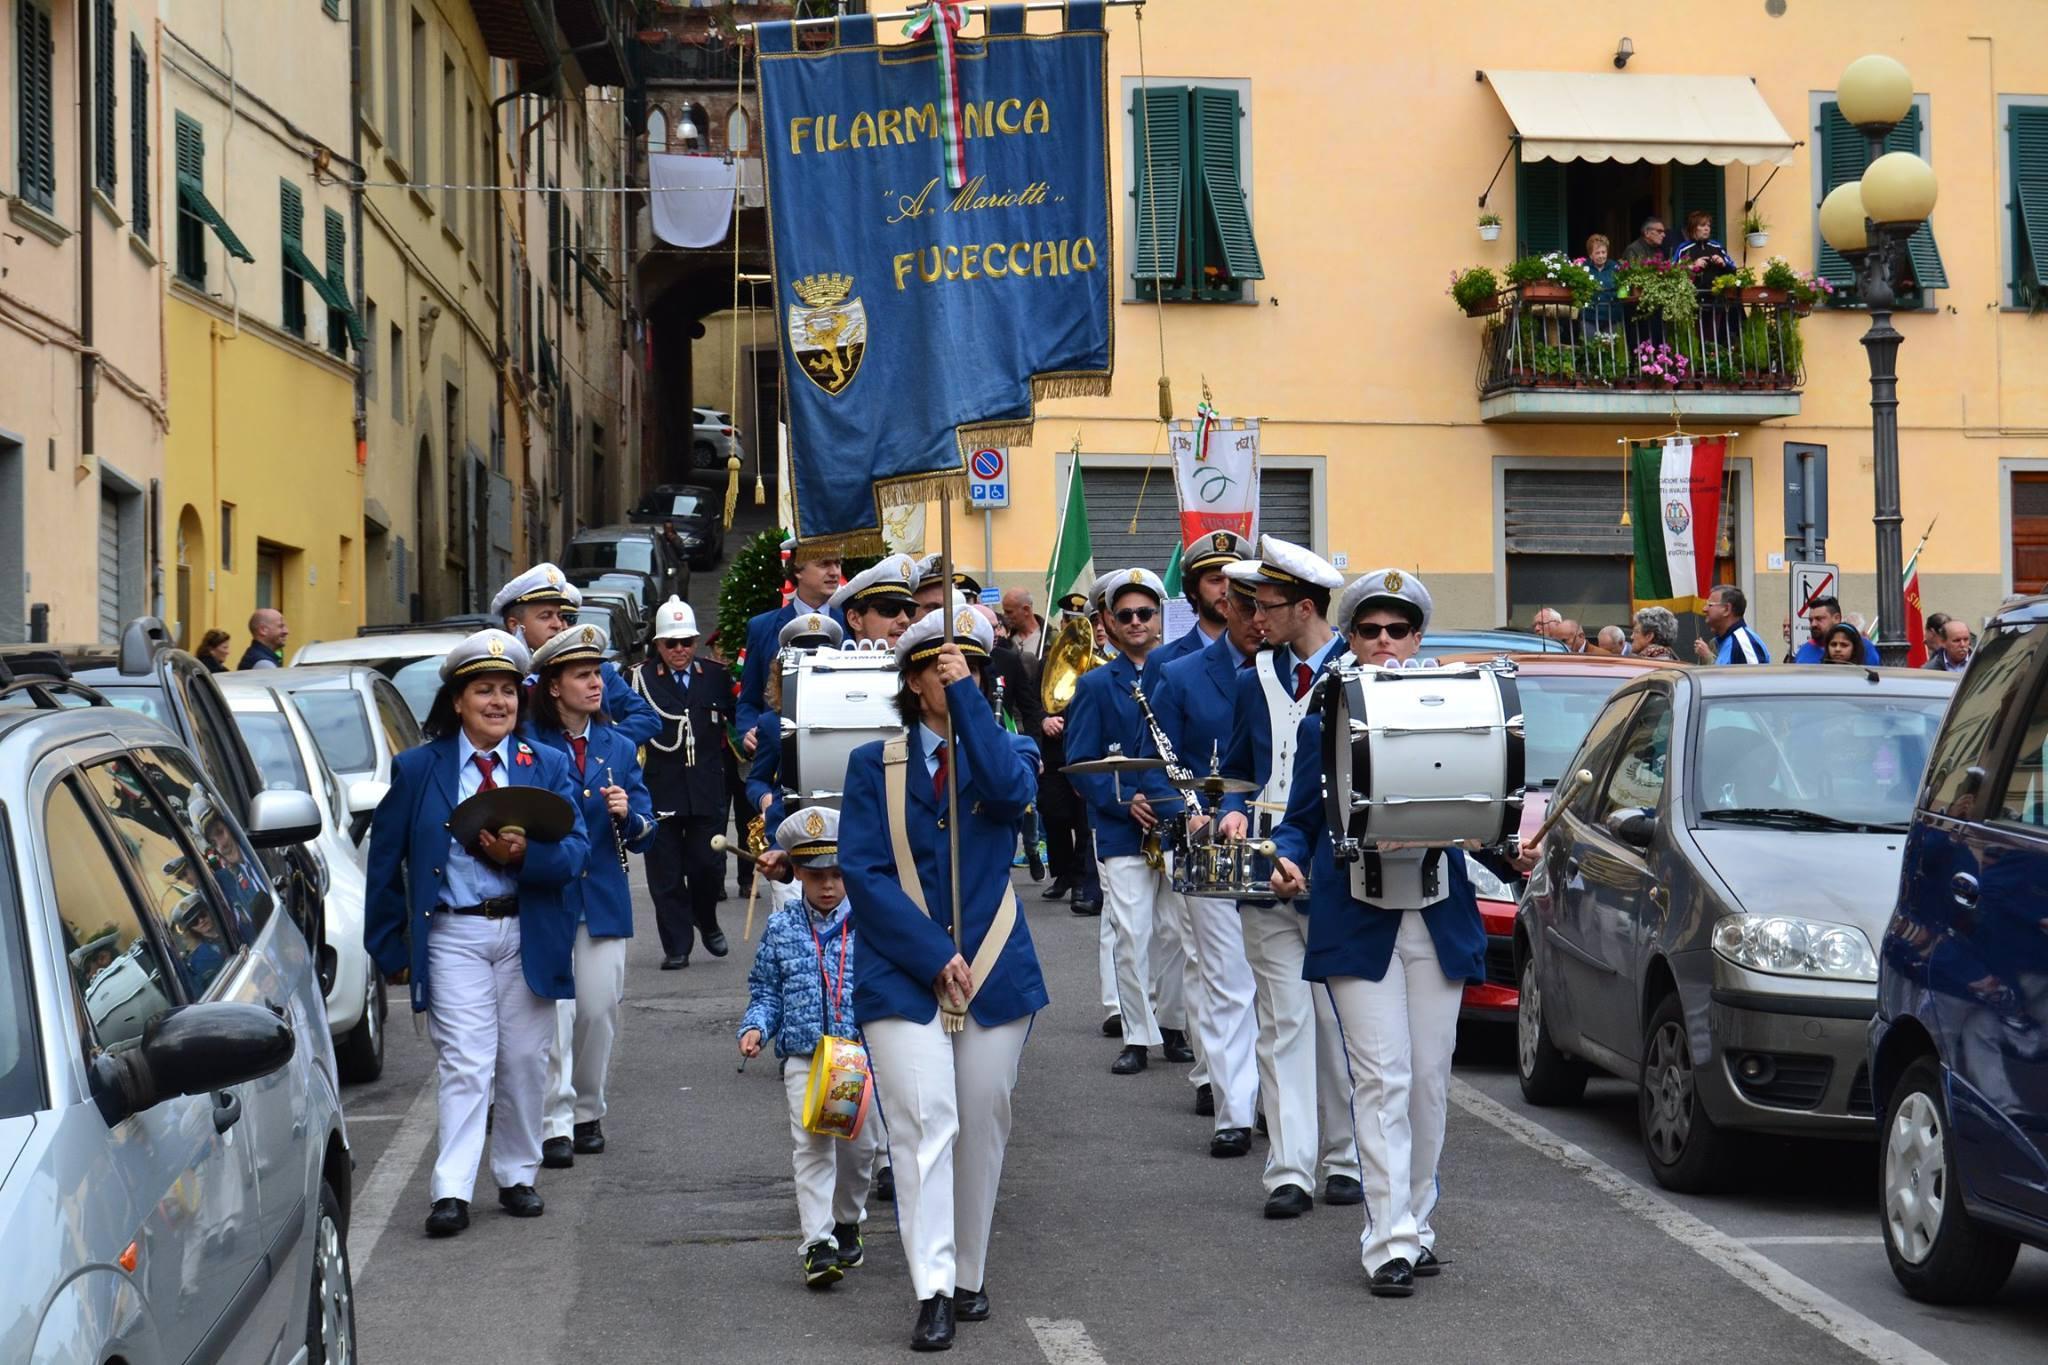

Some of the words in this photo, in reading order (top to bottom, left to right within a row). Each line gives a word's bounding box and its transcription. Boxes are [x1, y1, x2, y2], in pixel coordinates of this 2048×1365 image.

[790, 98, 1050, 154] FILARMNICA
[893, 237, 1097, 290] FUCECCHIO
[974, 486, 984, 498] P
[1334, 557, 1346, 566] 13
